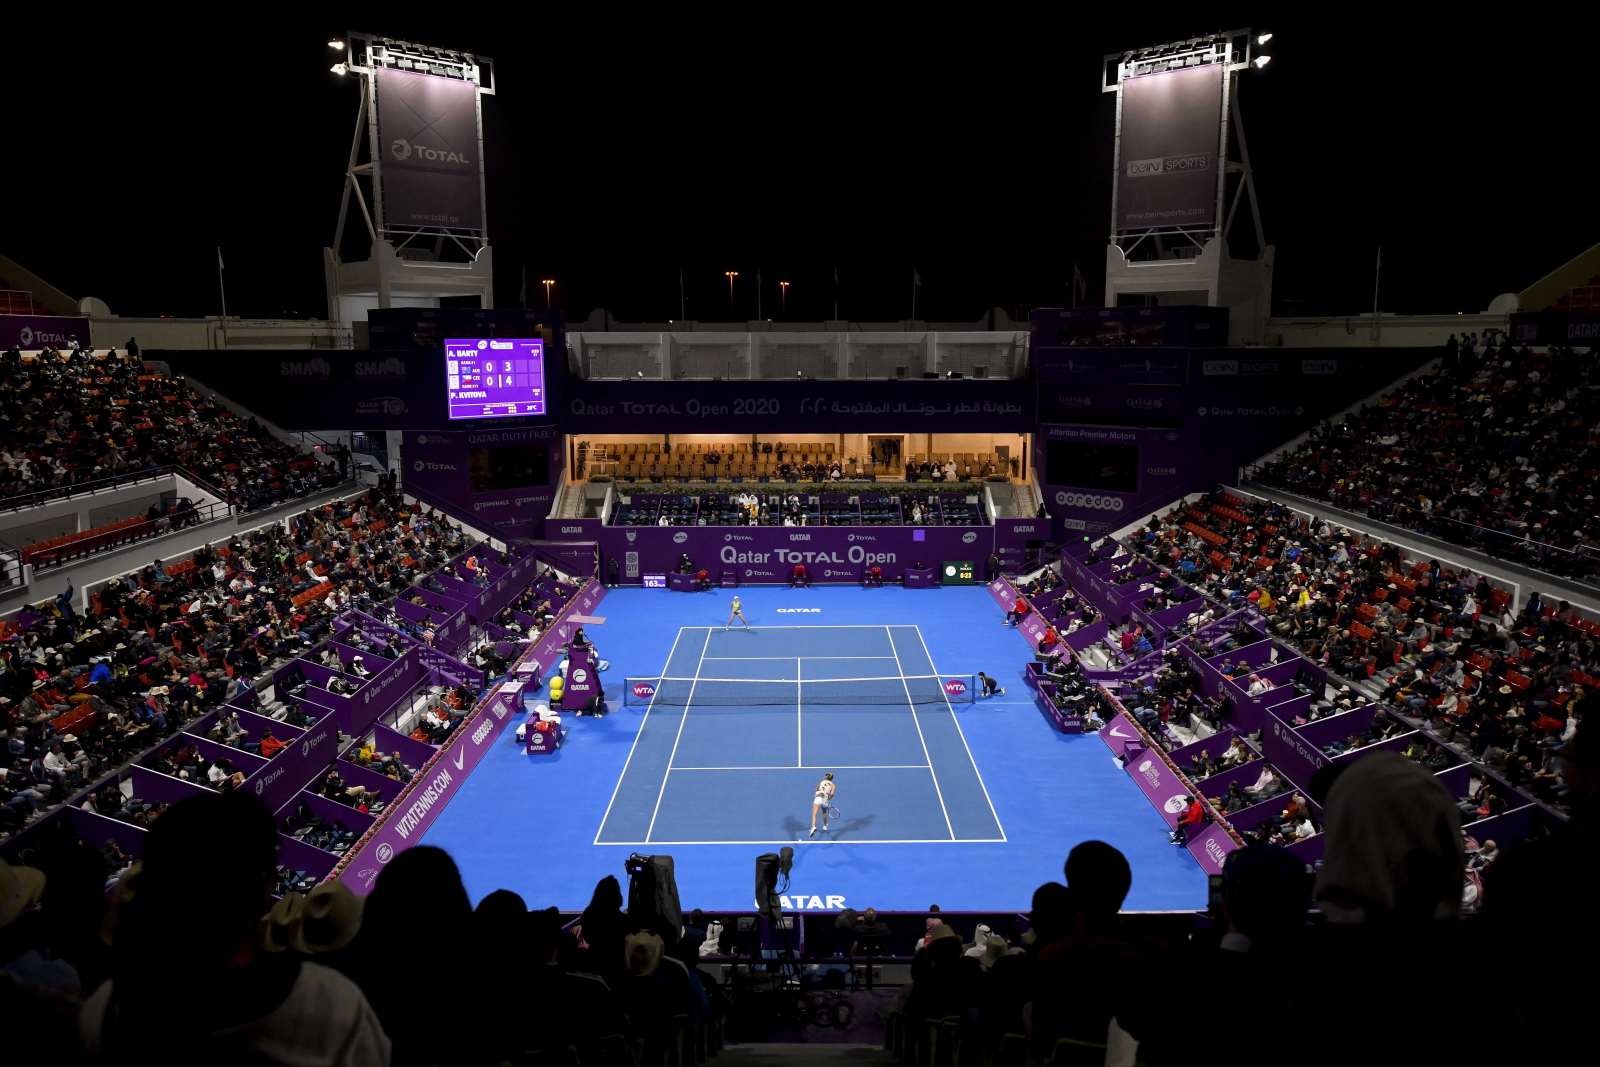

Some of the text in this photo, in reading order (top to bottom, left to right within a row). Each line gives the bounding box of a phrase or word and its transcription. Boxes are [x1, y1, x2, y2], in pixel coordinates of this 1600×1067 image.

[414, 145, 469, 164] TOTAL
[1166, 157, 1206, 170] SPORTS
[411, 212, 459, 223] www.total.qa
[1126, 207, 1205, 220] www.beinsports.com
[34, 330, 68, 343] TOTAL
[486, 362, 511, 372] 0 3
[1241, 363, 1279, 372] SPORTS
[486, 376, 512, 386] 0 4
[570, 398, 780, 418] Qatar TOTAL Open 2020
[831, 401, 890, 415] المفتوحة
[953, 401, 980, 415] قطر
[983, 400, 1022, 415] بطولة
[1211, 406, 1234, 416] Qatar
[1268, 406, 1290, 417] Open
[468, 430, 550, 444] QATAR DUTY FREE
[1049, 428, 1078, 437] Alfardan
[1080, 430, 1108, 439] Premier
[1109, 432, 1136, 440] Motors
[426, 462, 457, 470] TOTAL
[1057, 492, 1123, 511] ooredoo
[561, 526, 583, 534] QATAR
[1013, 525, 1035, 533] QATAR
[720, 545, 897, 566] Qatar TOTAL Open
[626, 564, 638, 572] QTF
[1223, 686, 1238, 704] TOTAL
[309, 731, 327, 749] TOTAL
[1281, 729, 1295, 748] Qatar
[1295, 742, 1316, 765] TOTAL
[264, 766, 285, 785] TOTAL
[395, 768, 453, 839] WTATENNIS.COM
[1170, 796, 1183, 812] WTA
[1206, 838, 1226, 859] QATAR
[755, 895, 847, 909] ATAR
